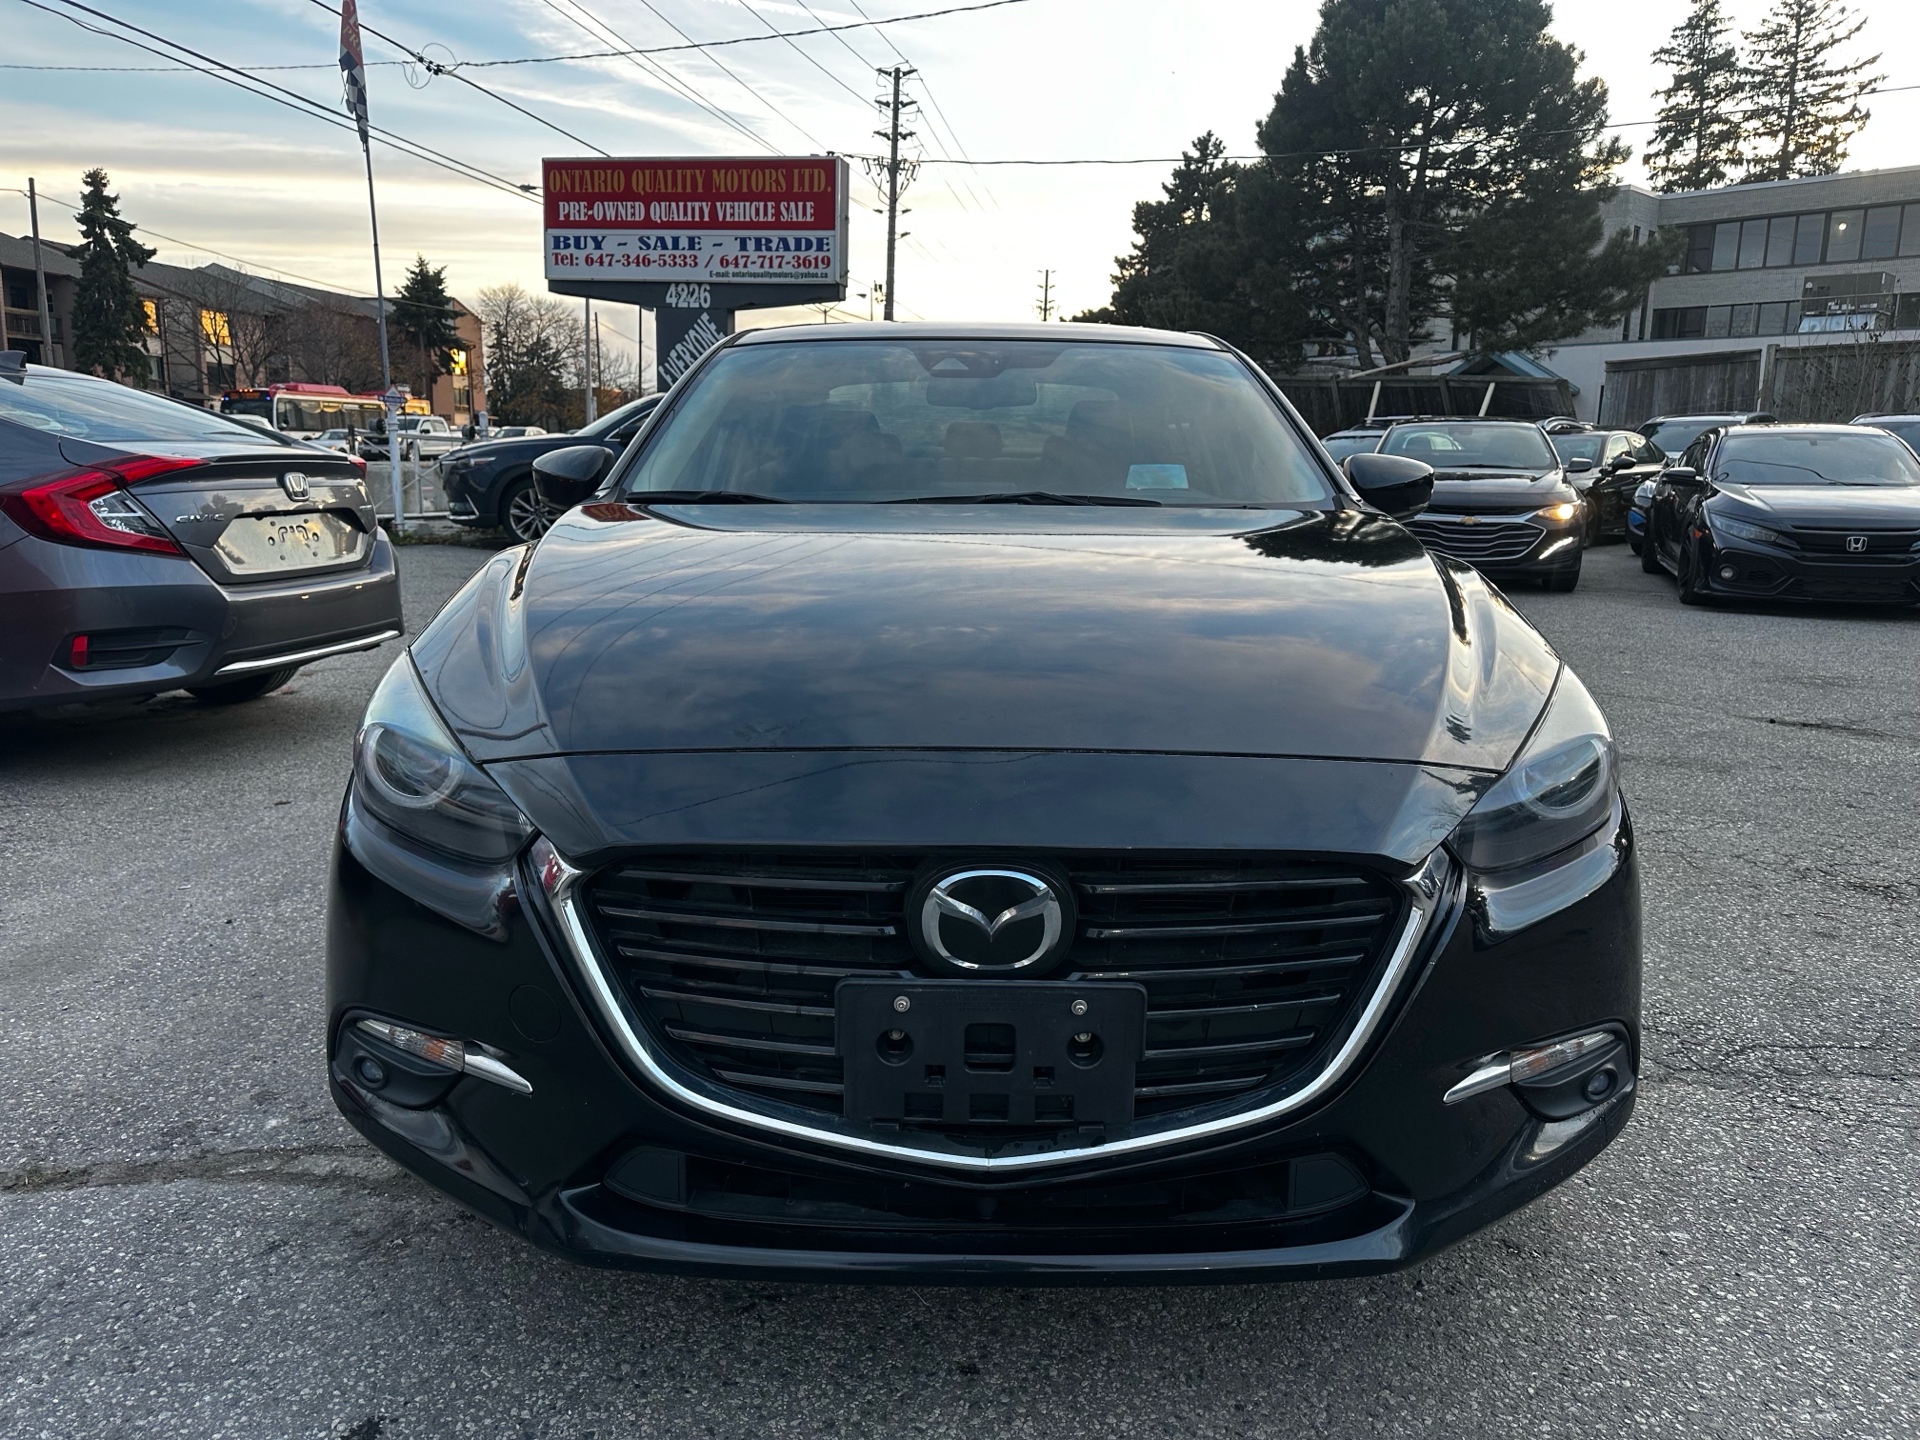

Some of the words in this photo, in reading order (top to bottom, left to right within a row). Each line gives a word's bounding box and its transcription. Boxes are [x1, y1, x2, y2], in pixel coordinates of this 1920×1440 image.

[549, 169, 625, 193] ONTARIO
[631, 169, 706, 195] QUALITY
[712, 168, 786, 193] MOTORS
[792, 168, 832, 193] LTD.
[558, 201, 645, 221] PRE-OWNED
[649, 201, 711, 223] QUALITY
[715, 201, 776, 221] VEHICLE
[780, 201, 815, 221] SALE
[552, 235, 607, 251] BUY
[638, 235, 702, 251] SALE
[734, 236, 831, 252] TRADE
[552, 252, 579, 266] Tel:
[584, 253, 699, 268] 647-346-5333
[719, 254, 831, 269] 647-717-3619
[709, 270, 731, 278] E-mail:
[731, 270, 829, 279] ontarioqualitymotors@yahoo.ca
[665, 283, 711, 309] 4226
[175, 513, 225, 523] CIVIC
